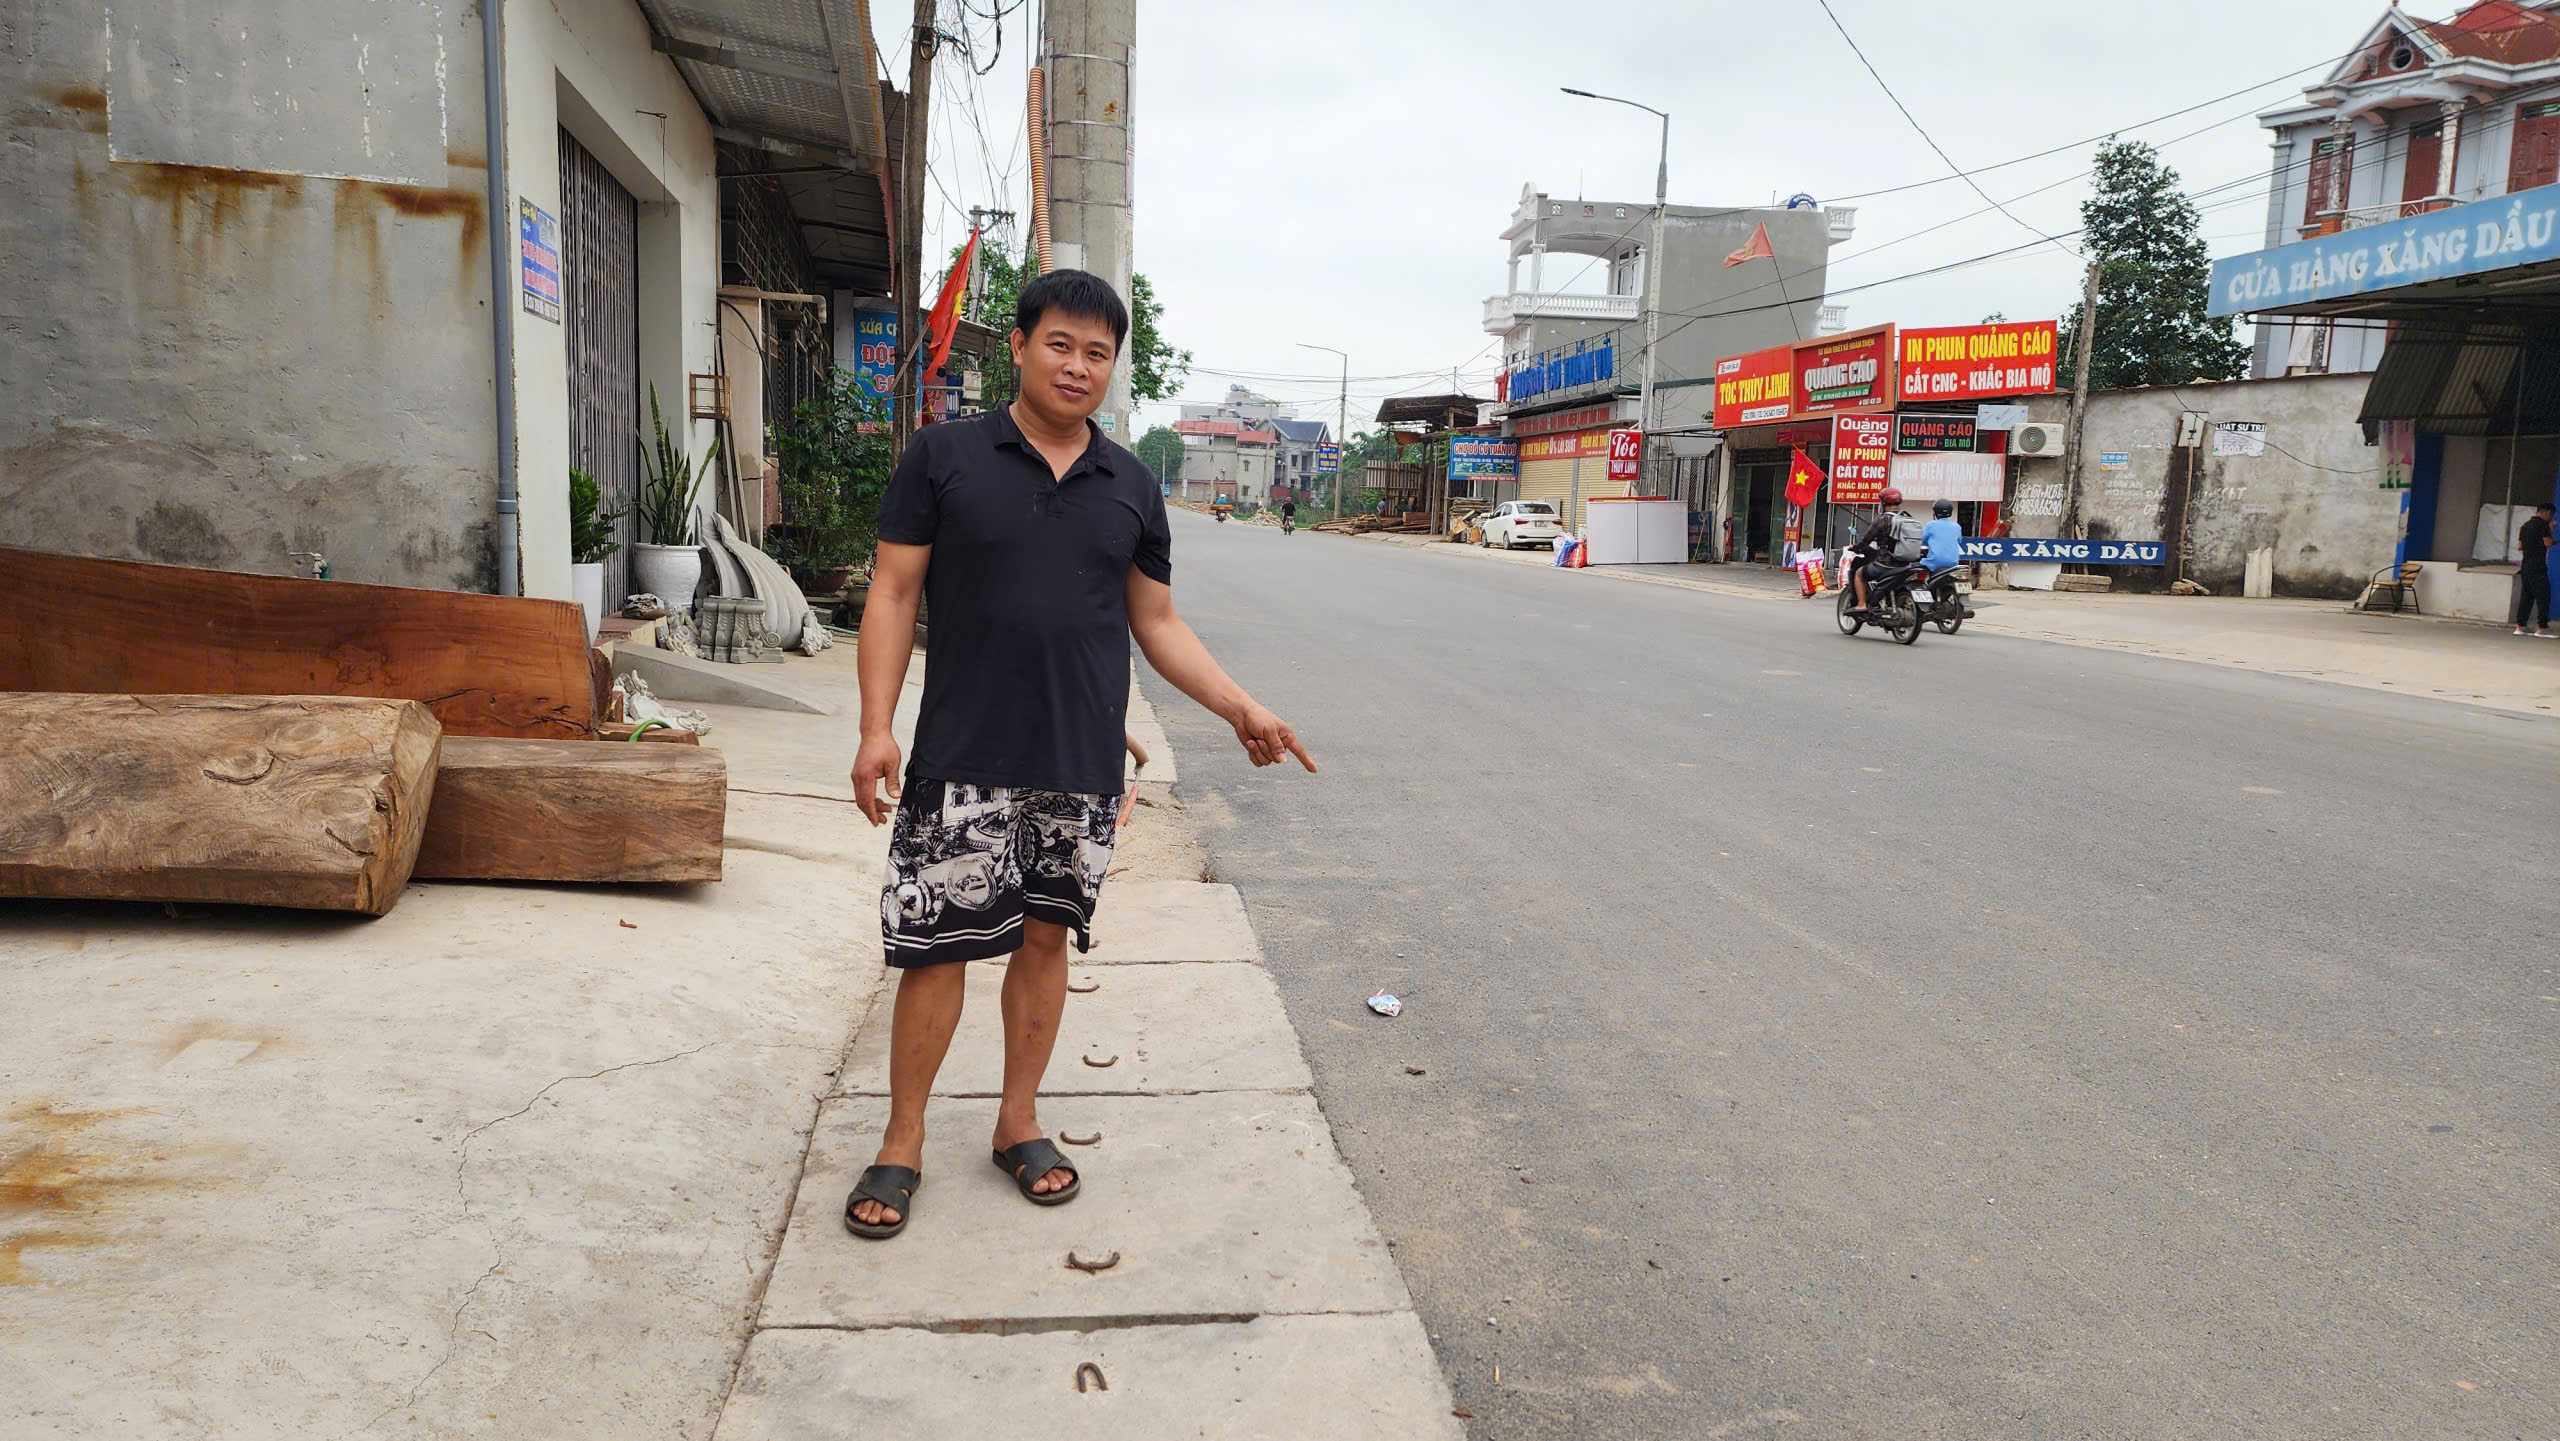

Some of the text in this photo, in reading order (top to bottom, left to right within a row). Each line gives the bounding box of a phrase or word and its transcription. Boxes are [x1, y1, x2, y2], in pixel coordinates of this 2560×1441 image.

[2229, 199, 2557, 302] CỬA HÀNG XĂNG DẦU
[1907, 326, 2051, 362] IN PHUN QUẢNG CÁO
[1804, 354, 1878, 392] QUẢNG CÁO
[1905, 367, 1930, 394] CẮT
[1932, 372, 1958, 393] CNC
[1969, 363, 2004, 391] KHẮC
[2006, 367, 2028, 388] BIA
[2030, 362, 2052, 390] MỘ
[1720, 378, 1737, 406] TÓC
[1738, 373, 1764, 404] THÙY
[1765, 371, 1790, 401] LINH
[1840, 417, 1889, 432] Quảng
[1902, 418, 1973, 437] QUẢNG CÁO
[1612, 433, 1639, 458] Tóc
[1858, 433, 1888, 446] Cáo
[1902, 437, 1917, 447] LED
[1923, 438, 1938, 448] ALU
[1944, 438, 1957, 448] BIA
[1838, 448, 1886, 461] IN PHUN
[1624, 460, 1637, 474] LINH
[1861, 465, 1886, 479] CNC
[1857, 482, 1870, 490] BIA
[2012, 540, 2090, 559] XĂNG
[2100, 542, 2159, 561] DẦU
